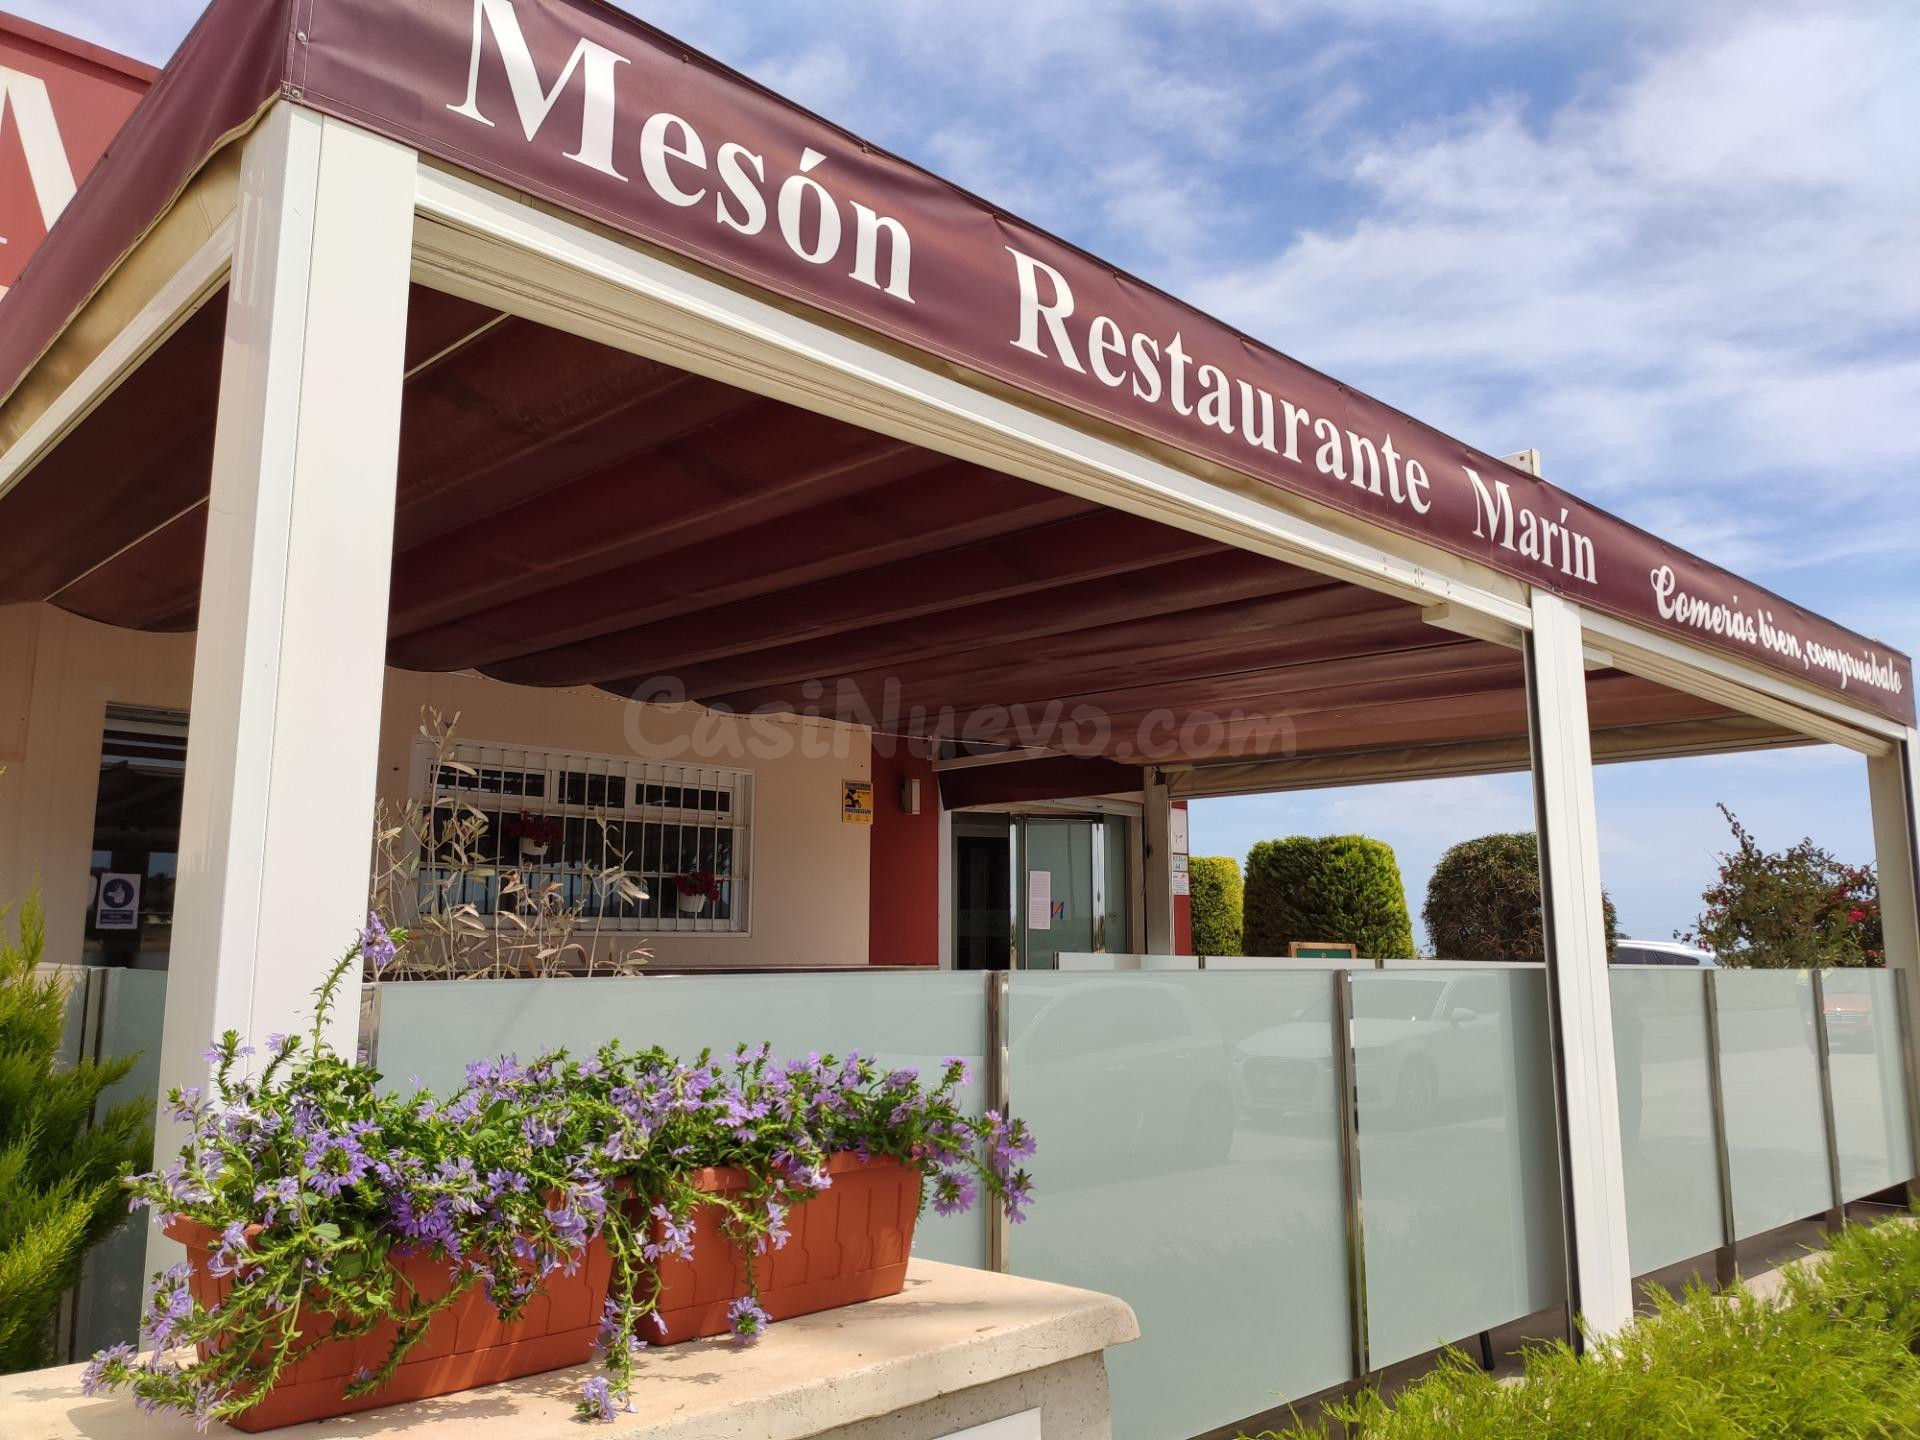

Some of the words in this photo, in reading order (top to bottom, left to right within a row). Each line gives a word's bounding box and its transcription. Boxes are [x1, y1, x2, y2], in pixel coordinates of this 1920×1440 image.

[446, 0, 915, 304] Mesón
[1005, 245, 1432, 515] Restaurante
[1462, 464, 1599, 585] Marín
[1651, 565, 1757, 644] Comerás
